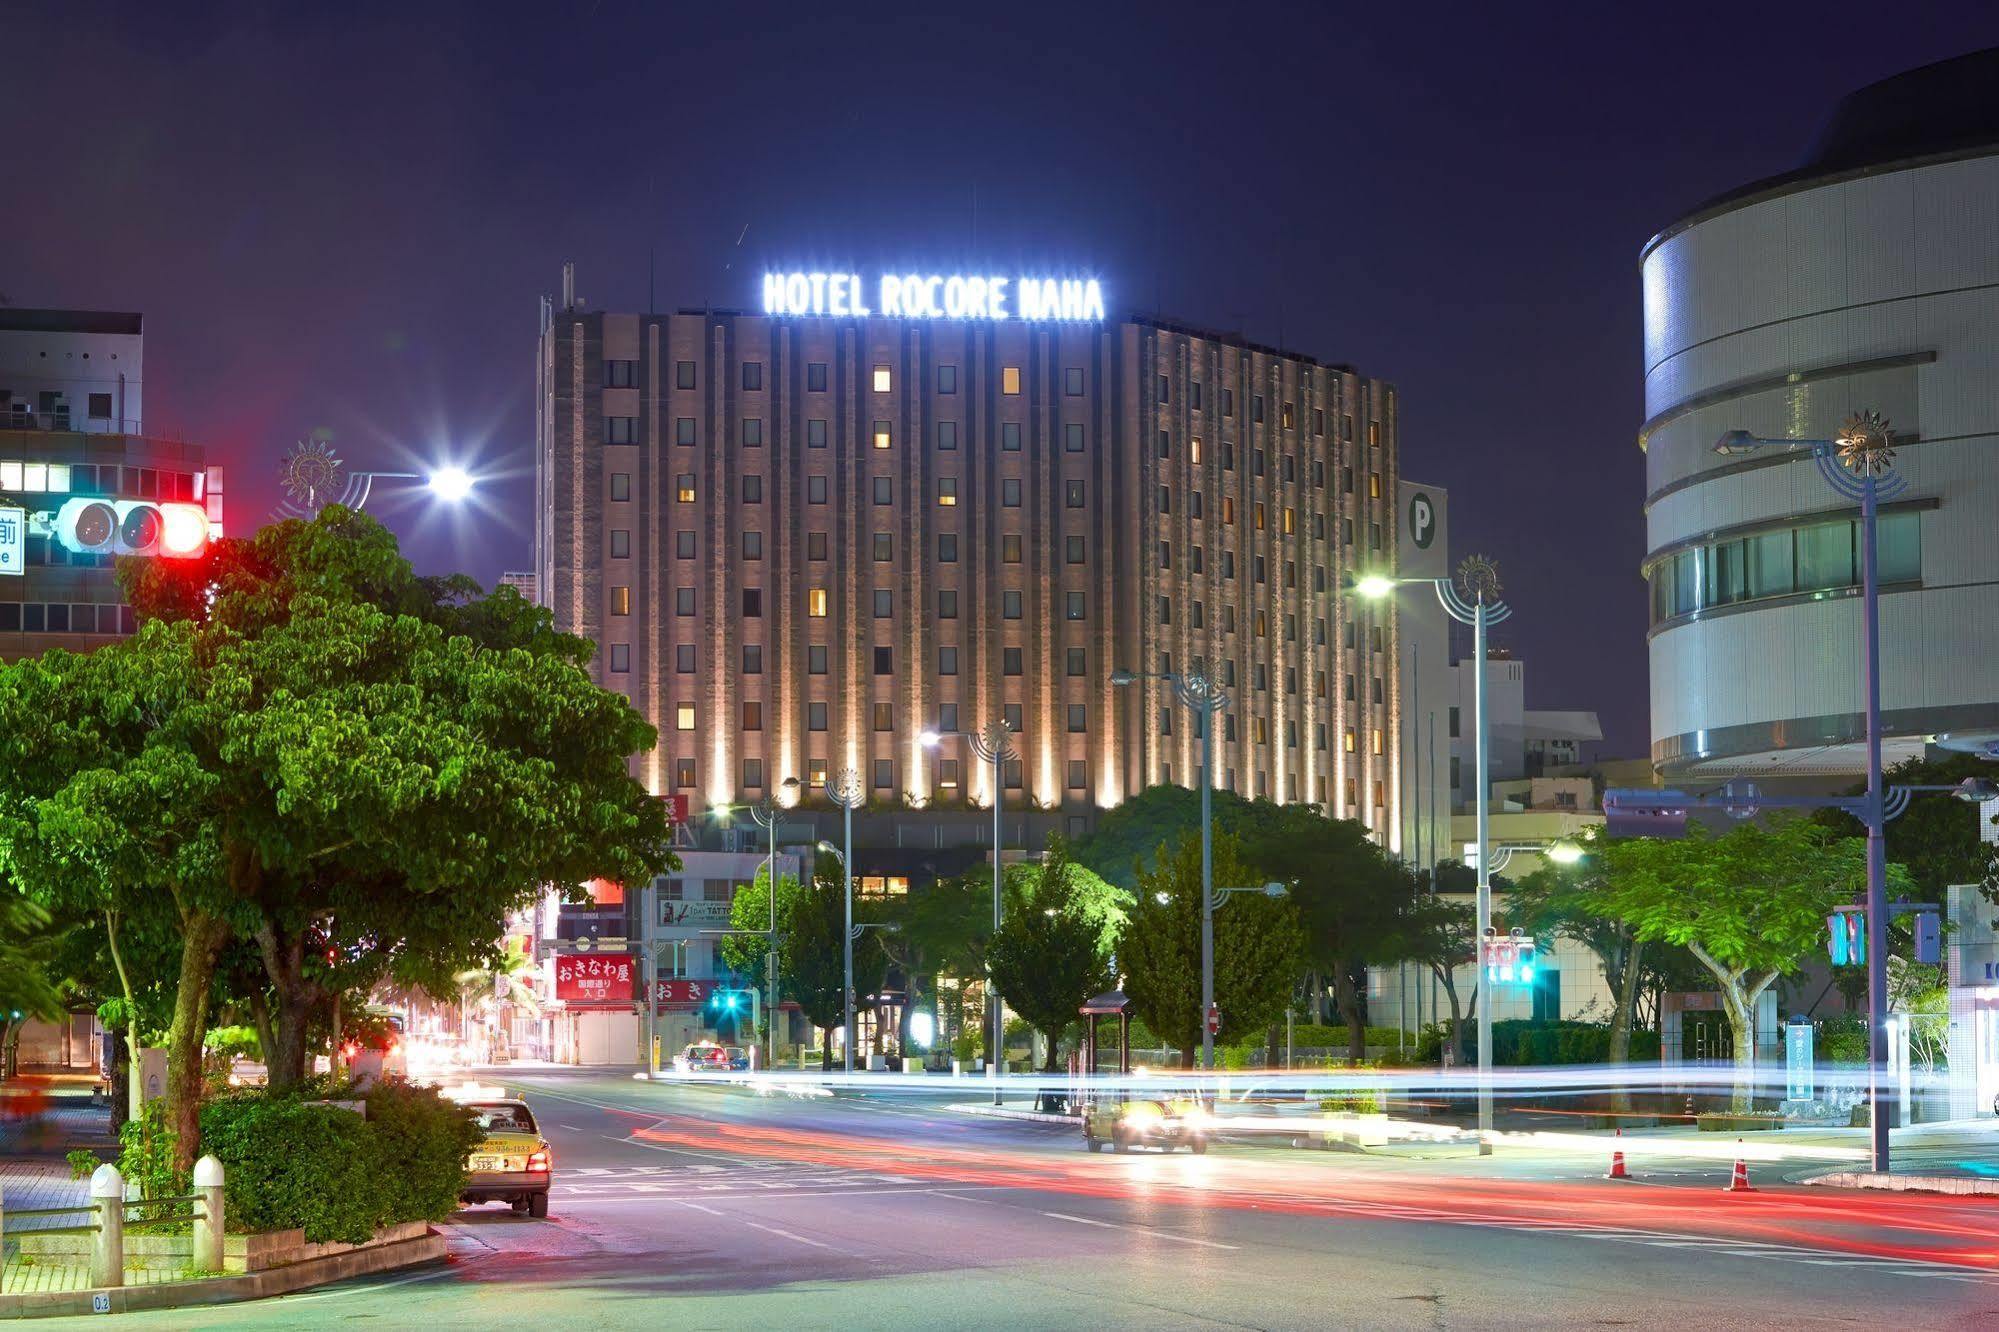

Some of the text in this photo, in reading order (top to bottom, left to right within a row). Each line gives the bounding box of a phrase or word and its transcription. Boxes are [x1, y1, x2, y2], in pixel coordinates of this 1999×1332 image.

[763, 273, 1106, 320] HOTEL ROCORE NAHA
[558, 957, 630, 983] おきなわ屋
[95, 1296, 109, 1310] 0.2
